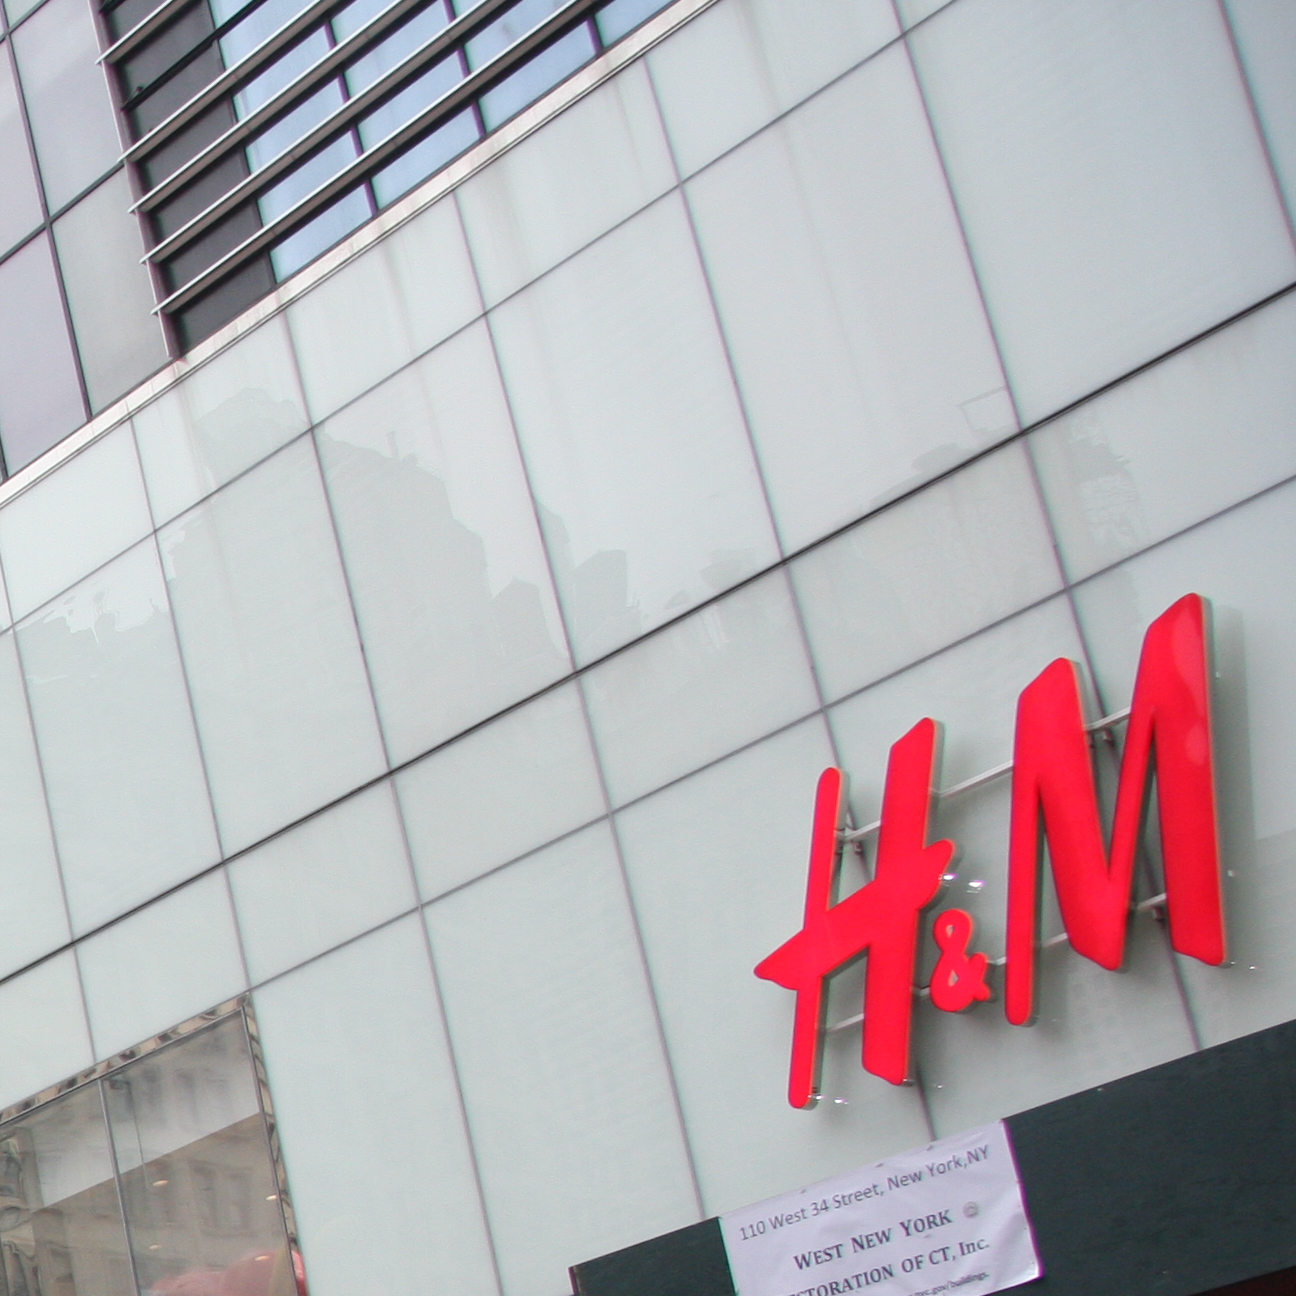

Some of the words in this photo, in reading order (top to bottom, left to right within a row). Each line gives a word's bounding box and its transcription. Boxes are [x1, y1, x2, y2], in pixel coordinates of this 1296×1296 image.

[753, 591, 1231, 1112] H&M
[739, 1219, 766, 1241] 110
[768, 1208, 807, 1230] West
[811, 1198, 829, 1217] 34
[832, 1184, 885, 1210] Street,
[887, 1171, 923, 1192] New
[793, 1243, 844, 1272] WEST
[851, 1227, 892, 1255] NEW
[899, 1209, 953, 1239] YORK
[901, 1253, 924, 1274] OF
[928, 1245, 956, 1267] CT,
[959, 1235, 990, 1258] Inc.
